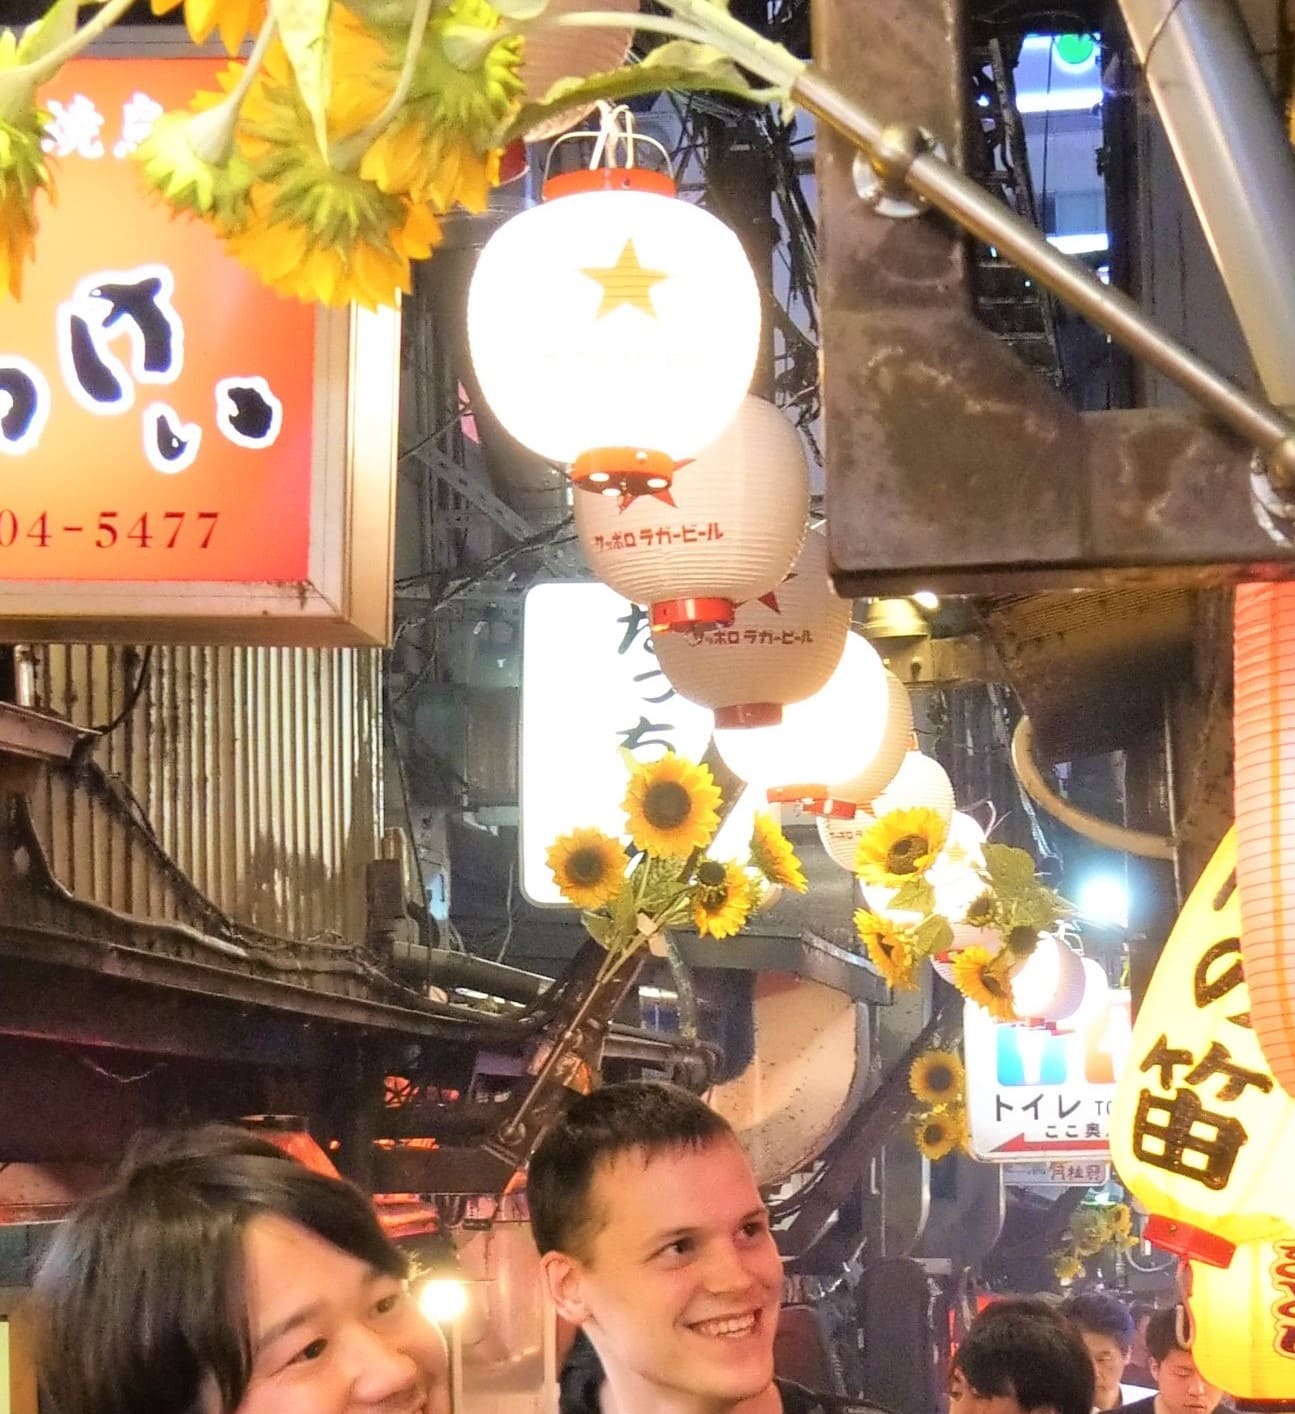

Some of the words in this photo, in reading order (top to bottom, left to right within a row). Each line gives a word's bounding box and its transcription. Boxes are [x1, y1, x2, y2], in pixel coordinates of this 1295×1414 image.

[995, 1093, 1082, 1122] トイレ
[1045, 1122, 1110, 1139] ここ奥
